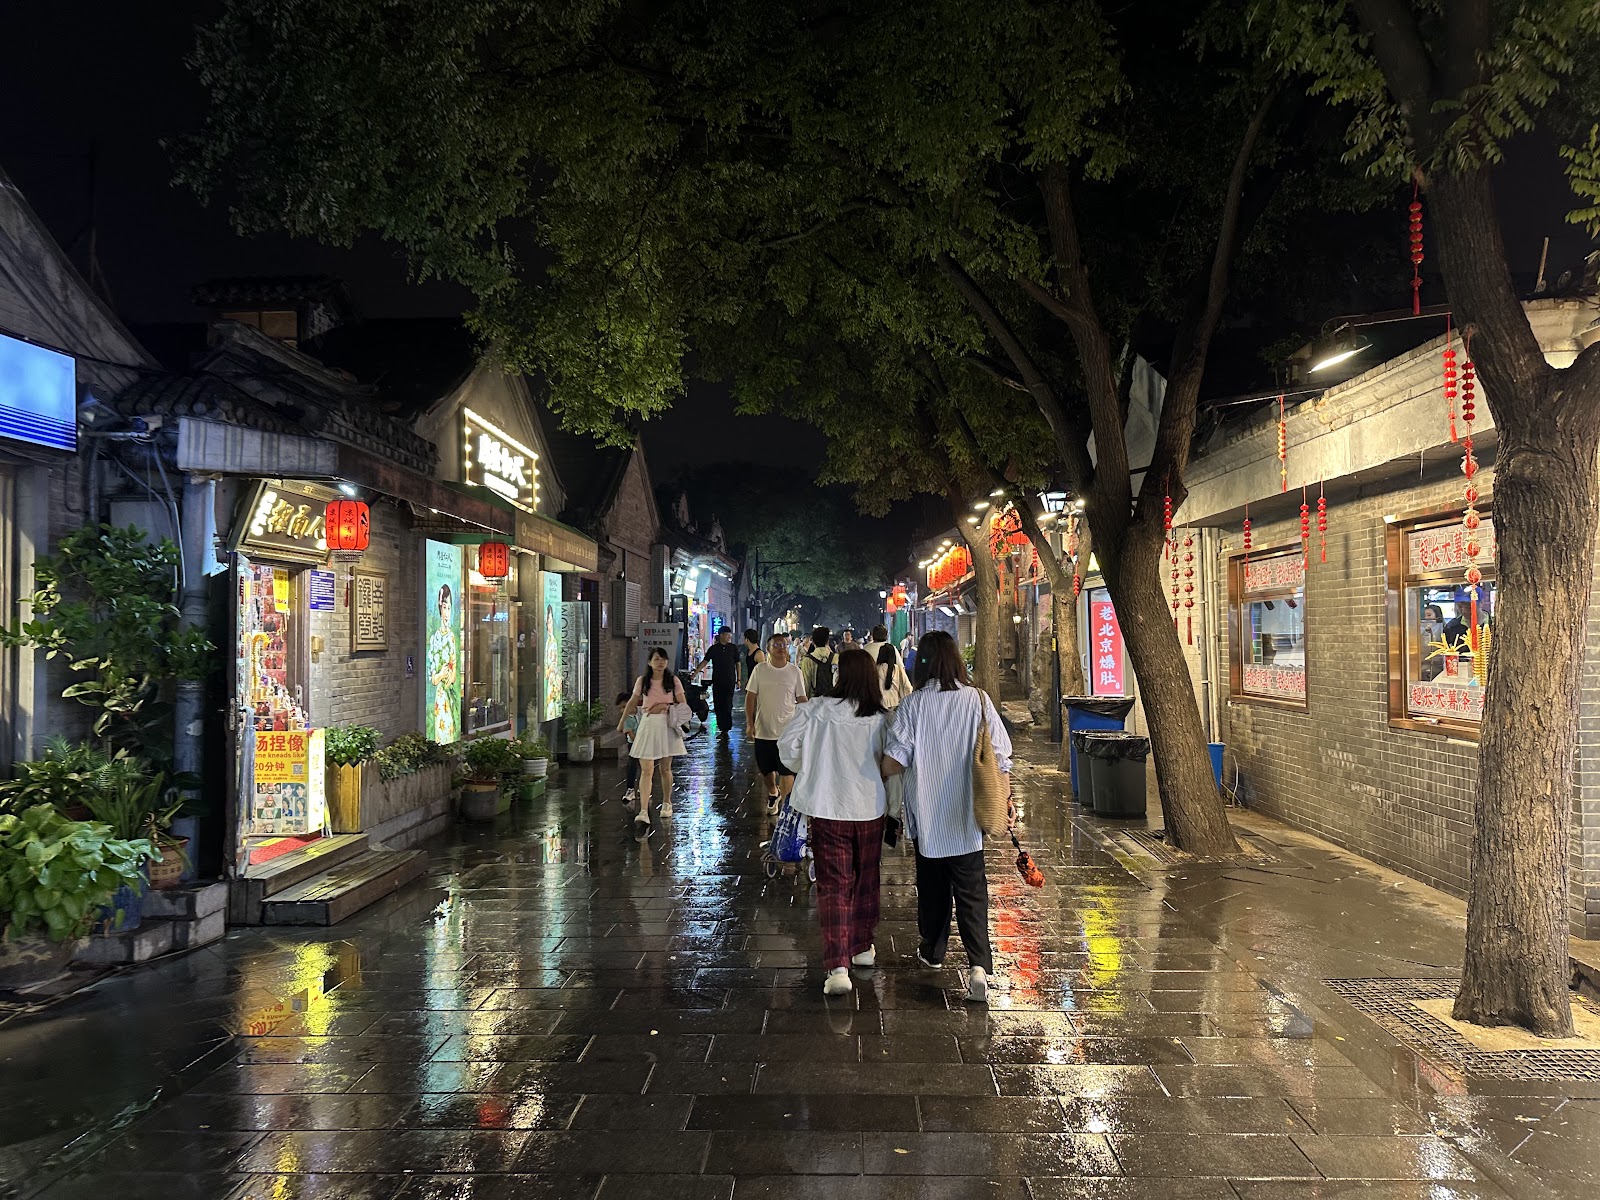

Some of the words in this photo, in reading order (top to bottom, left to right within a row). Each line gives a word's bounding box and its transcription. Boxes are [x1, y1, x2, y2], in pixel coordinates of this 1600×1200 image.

[1419, 528, 1476, 567] 超长大薯
[1098, 605, 1117, 686] 老北京爆肚
[1412, 685, 1471, 712] 超长大薯条
